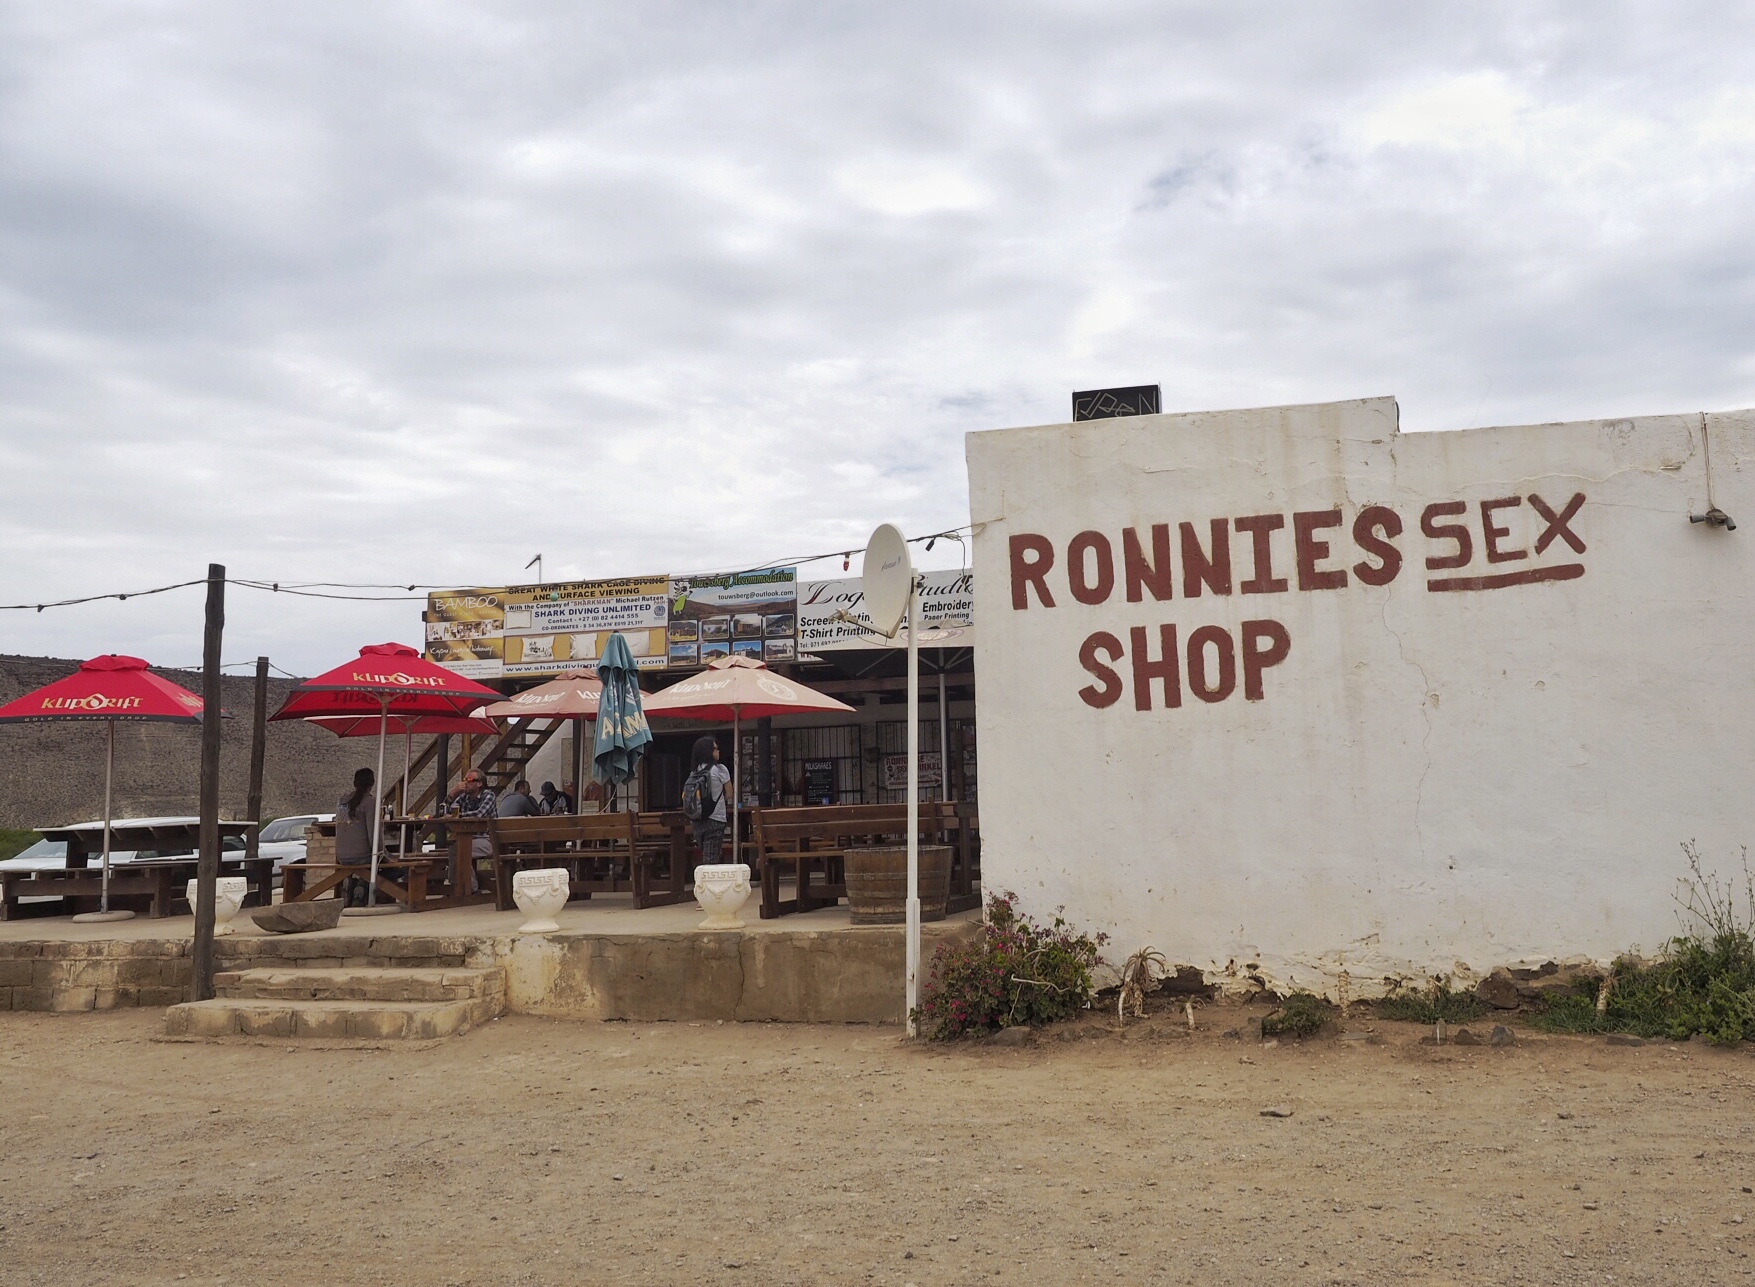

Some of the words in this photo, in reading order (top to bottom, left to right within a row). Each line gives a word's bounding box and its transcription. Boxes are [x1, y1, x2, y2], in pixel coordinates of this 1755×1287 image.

[1008, 506, 1403, 610] RONNIES
[1420, 492, 1587, 570] SEX
[508, 587, 536, 595] GREAT
[540, 584, 569, 592] WHITE
[571, 581, 603, 590] SHARK
[633, 578, 665, 586] DIVING
[690, 576, 731, 590] Touwsberg
[731, 570, 794, 587] Accommodation
[599, 588, 640, 597] VIEWING
[718, 590, 794, 600] touwsberg@outlook.com
[800, 581, 865, 609] Log
[434, 595, 498, 611] BAMBOO
[536, 600, 562, 609] Company
[534, 609, 566, 618] SHARK
[568, 607, 600, 616] DIVING
[602, 604, 651, 613] UNLIMITED
[944, 611, 970, 620] Printing
[800, 616, 834, 627] Scree
[800, 628, 834, 639] T-Shirt
[506, 658, 664, 673] www.sharkdivingu.com
[1078, 619, 1291, 711] SHOP
